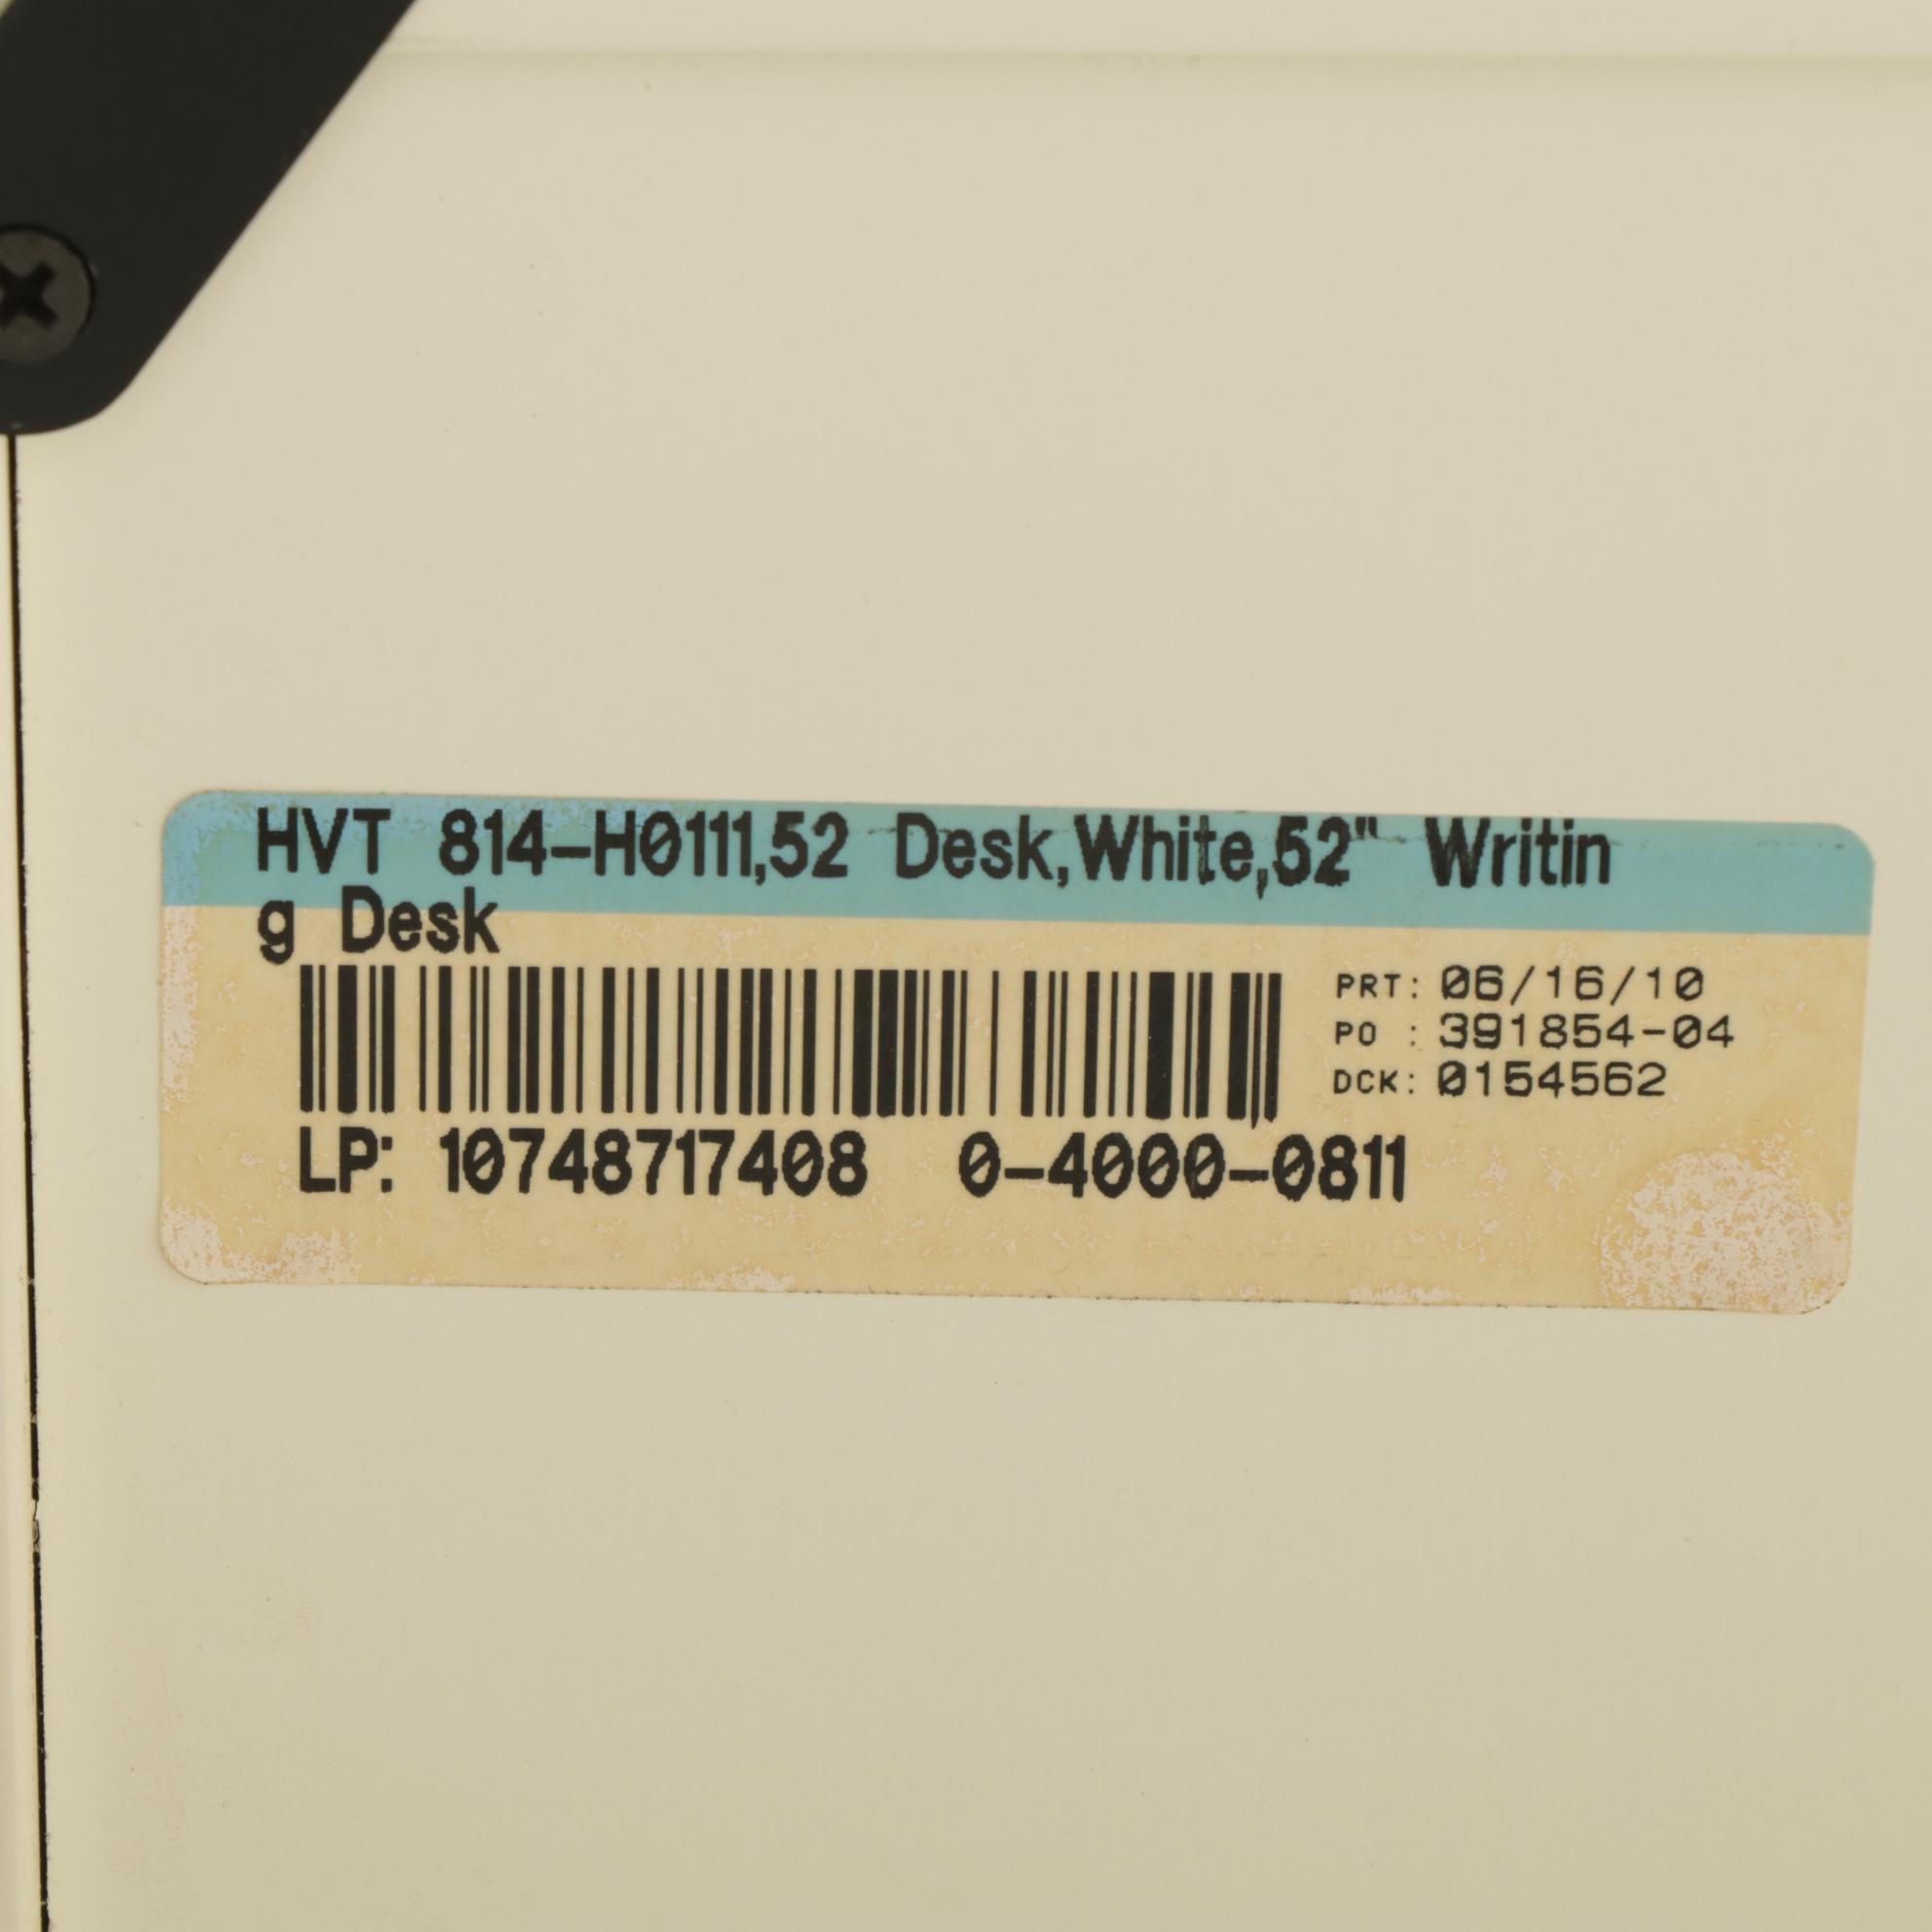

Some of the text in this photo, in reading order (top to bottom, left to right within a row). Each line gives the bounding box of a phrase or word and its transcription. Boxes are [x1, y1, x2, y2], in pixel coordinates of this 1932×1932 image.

[257, 807, 391, 874] HVT
[439, 808, 849, 885] 814-H0111,52
[1425, 817, 1611, 888] Writin
[258, 885, 500, 965] g Desk
[1337, 965, 1703, 1005] PRT: 06/16/10
[1336, 1022, 1376, 1046] PO
[1440, 1013, 1733, 1050] 391854-04
[1334, 1060, 1665, 1097] DCK: 0154562
[300, 1127, 1405, 1203] LP: 10748717408 0-4000-0811
